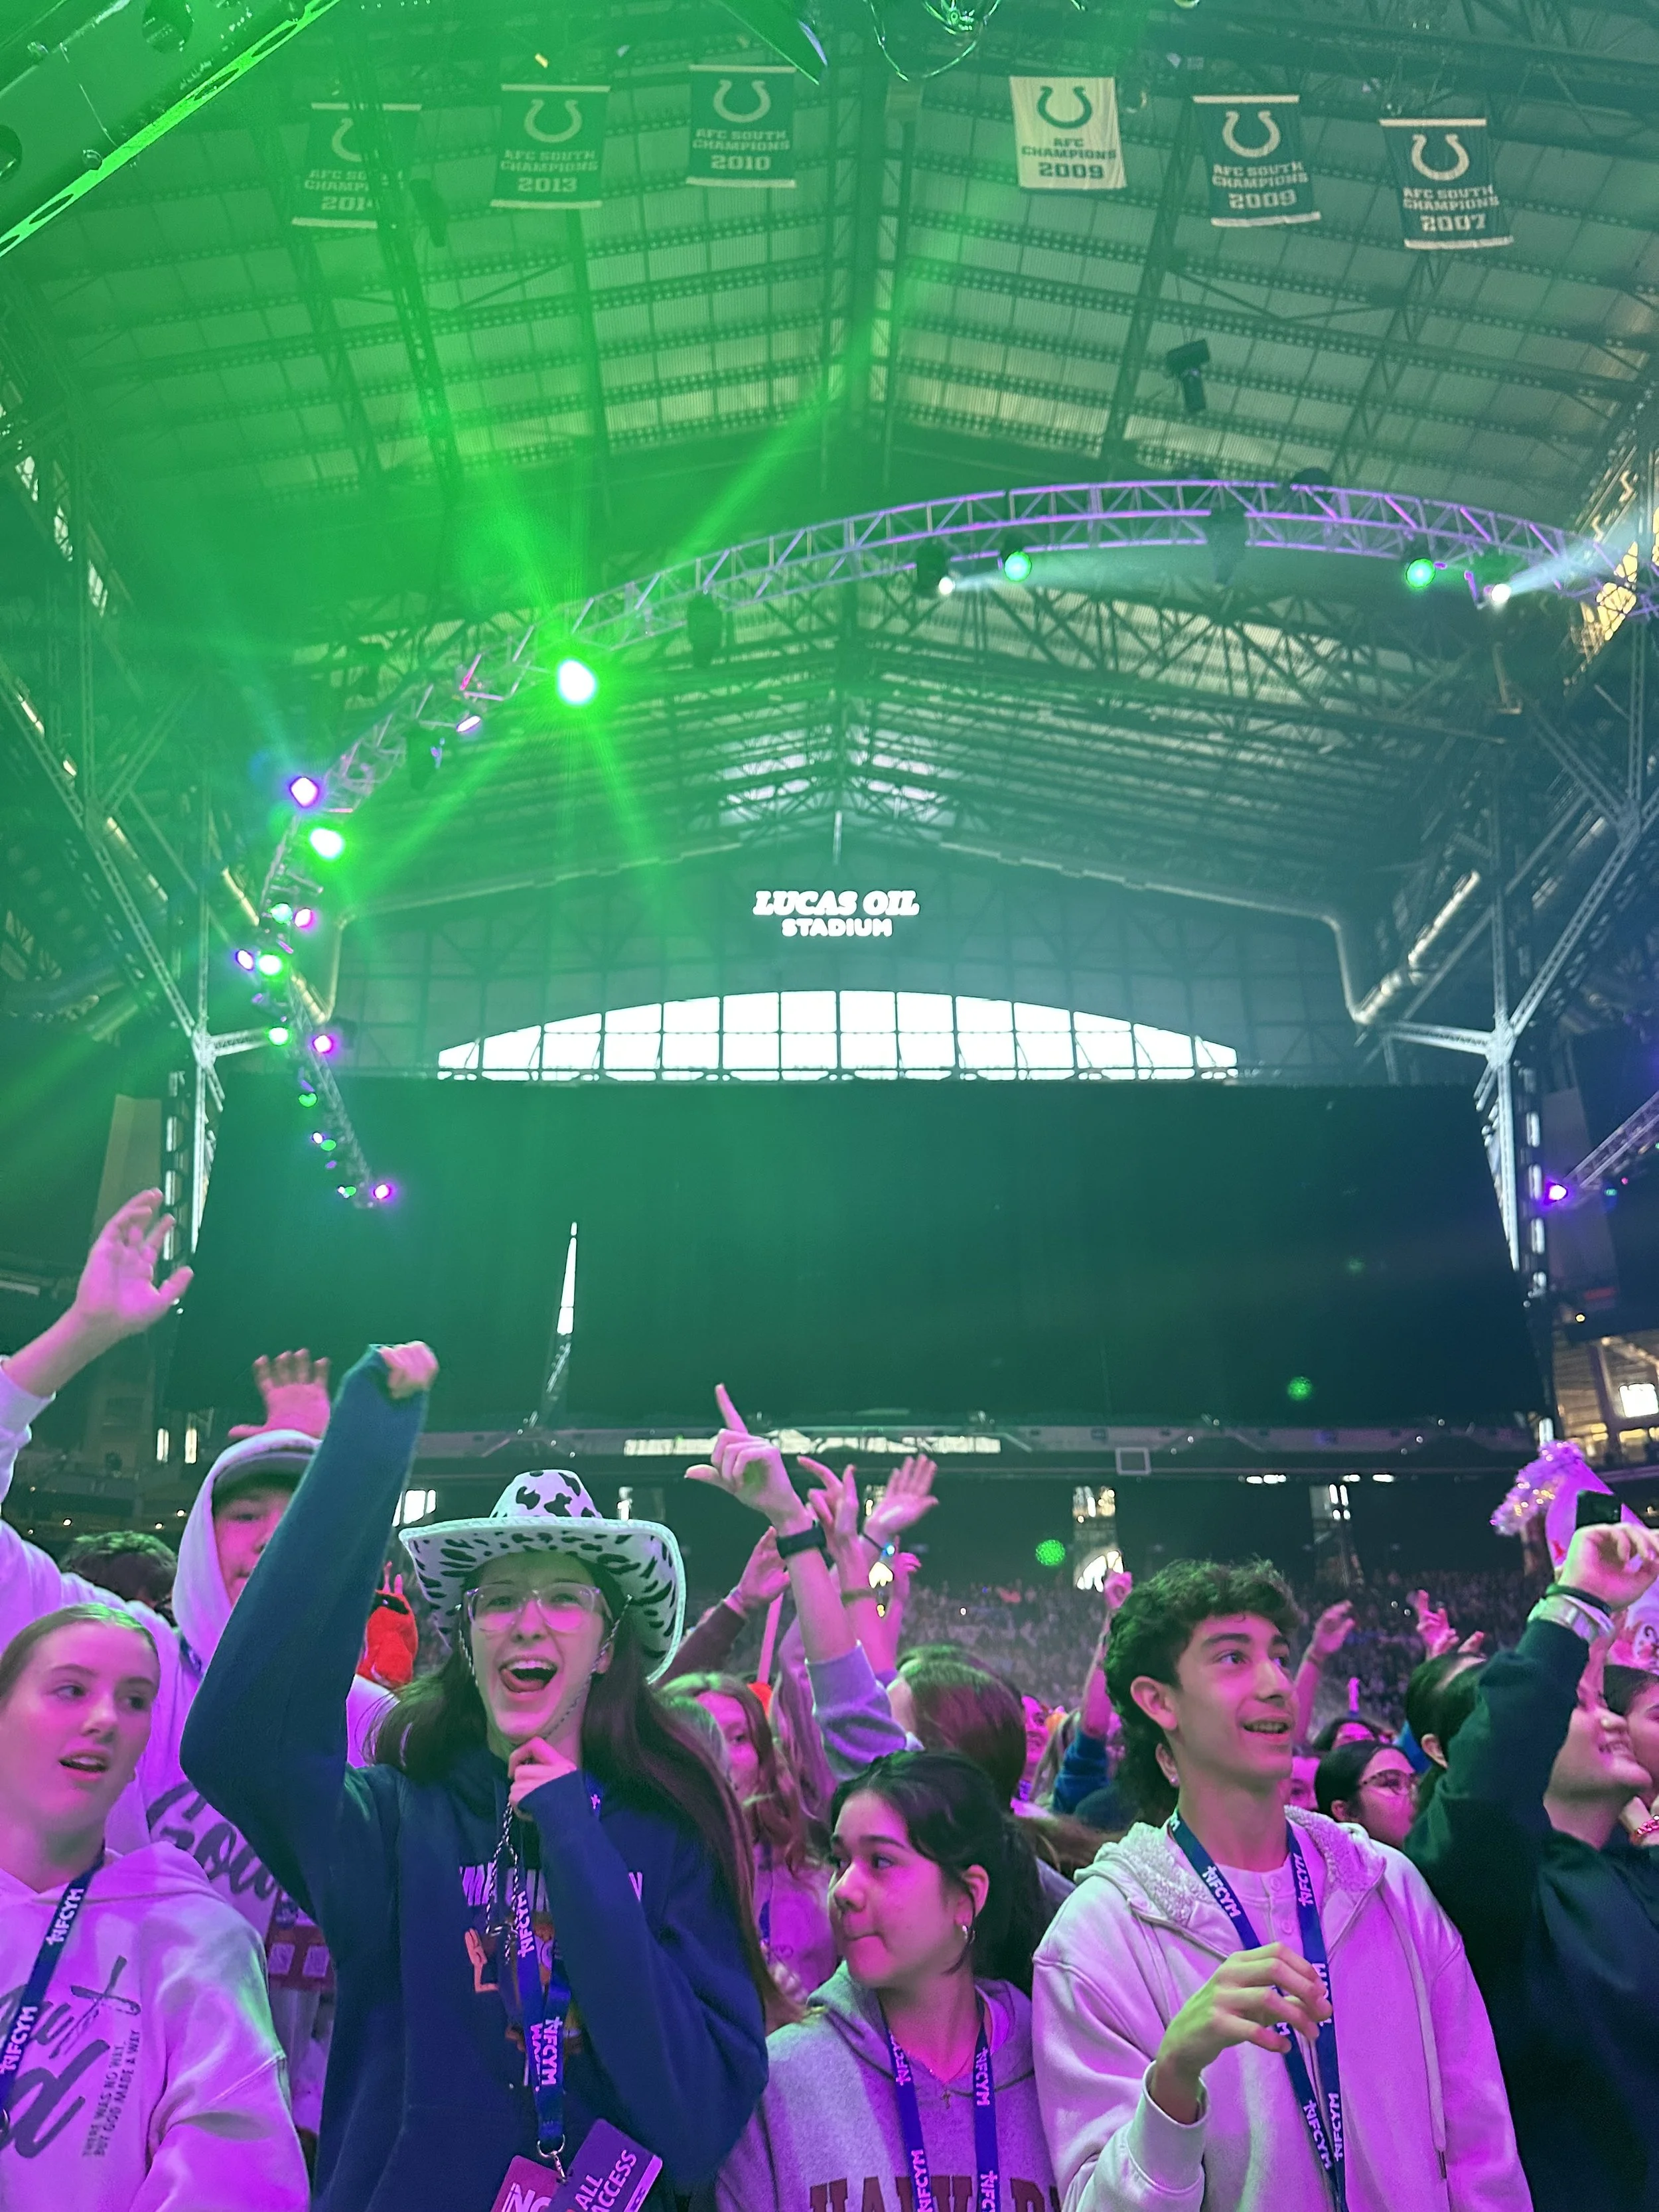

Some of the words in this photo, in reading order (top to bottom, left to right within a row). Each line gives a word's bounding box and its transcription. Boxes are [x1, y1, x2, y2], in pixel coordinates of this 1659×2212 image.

[696, 129, 727, 139] AFC
[731, 130, 786, 140] SOUTH
[1054, 137, 1084, 147] AFC
[692, 139, 790, 151] CHAMPIONS
[1021, 145, 1116, 159] CHAMPIONS
[505, 149, 536, 161] AFC
[540, 151, 595, 161] SOUTH
[500, 161, 598, 173] CHAMPIONS
[711, 155, 772, 171] 2010
[1039, 162, 1104, 179] 2009
[1213, 164, 1244, 177] AFC
[1246, 161, 1304, 177] SOUTH
[518, 177, 577, 192] 2013
[1212, 172, 1309, 188] CHAMPIONS
[1403, 187, 1433, 199] AFC
[1437, 184, 1494, 199] SOUTH
[1403, 196, 1499, 210] CHAMPIONS
[1420, 213, 1486, 232] 2007
[753, 890, 858, 915] LUCAS
[863, 890, 920, 915] OIL
[782, 918, 893, 936] STADIUM
[575, 2174, 603, 2211] ALL
